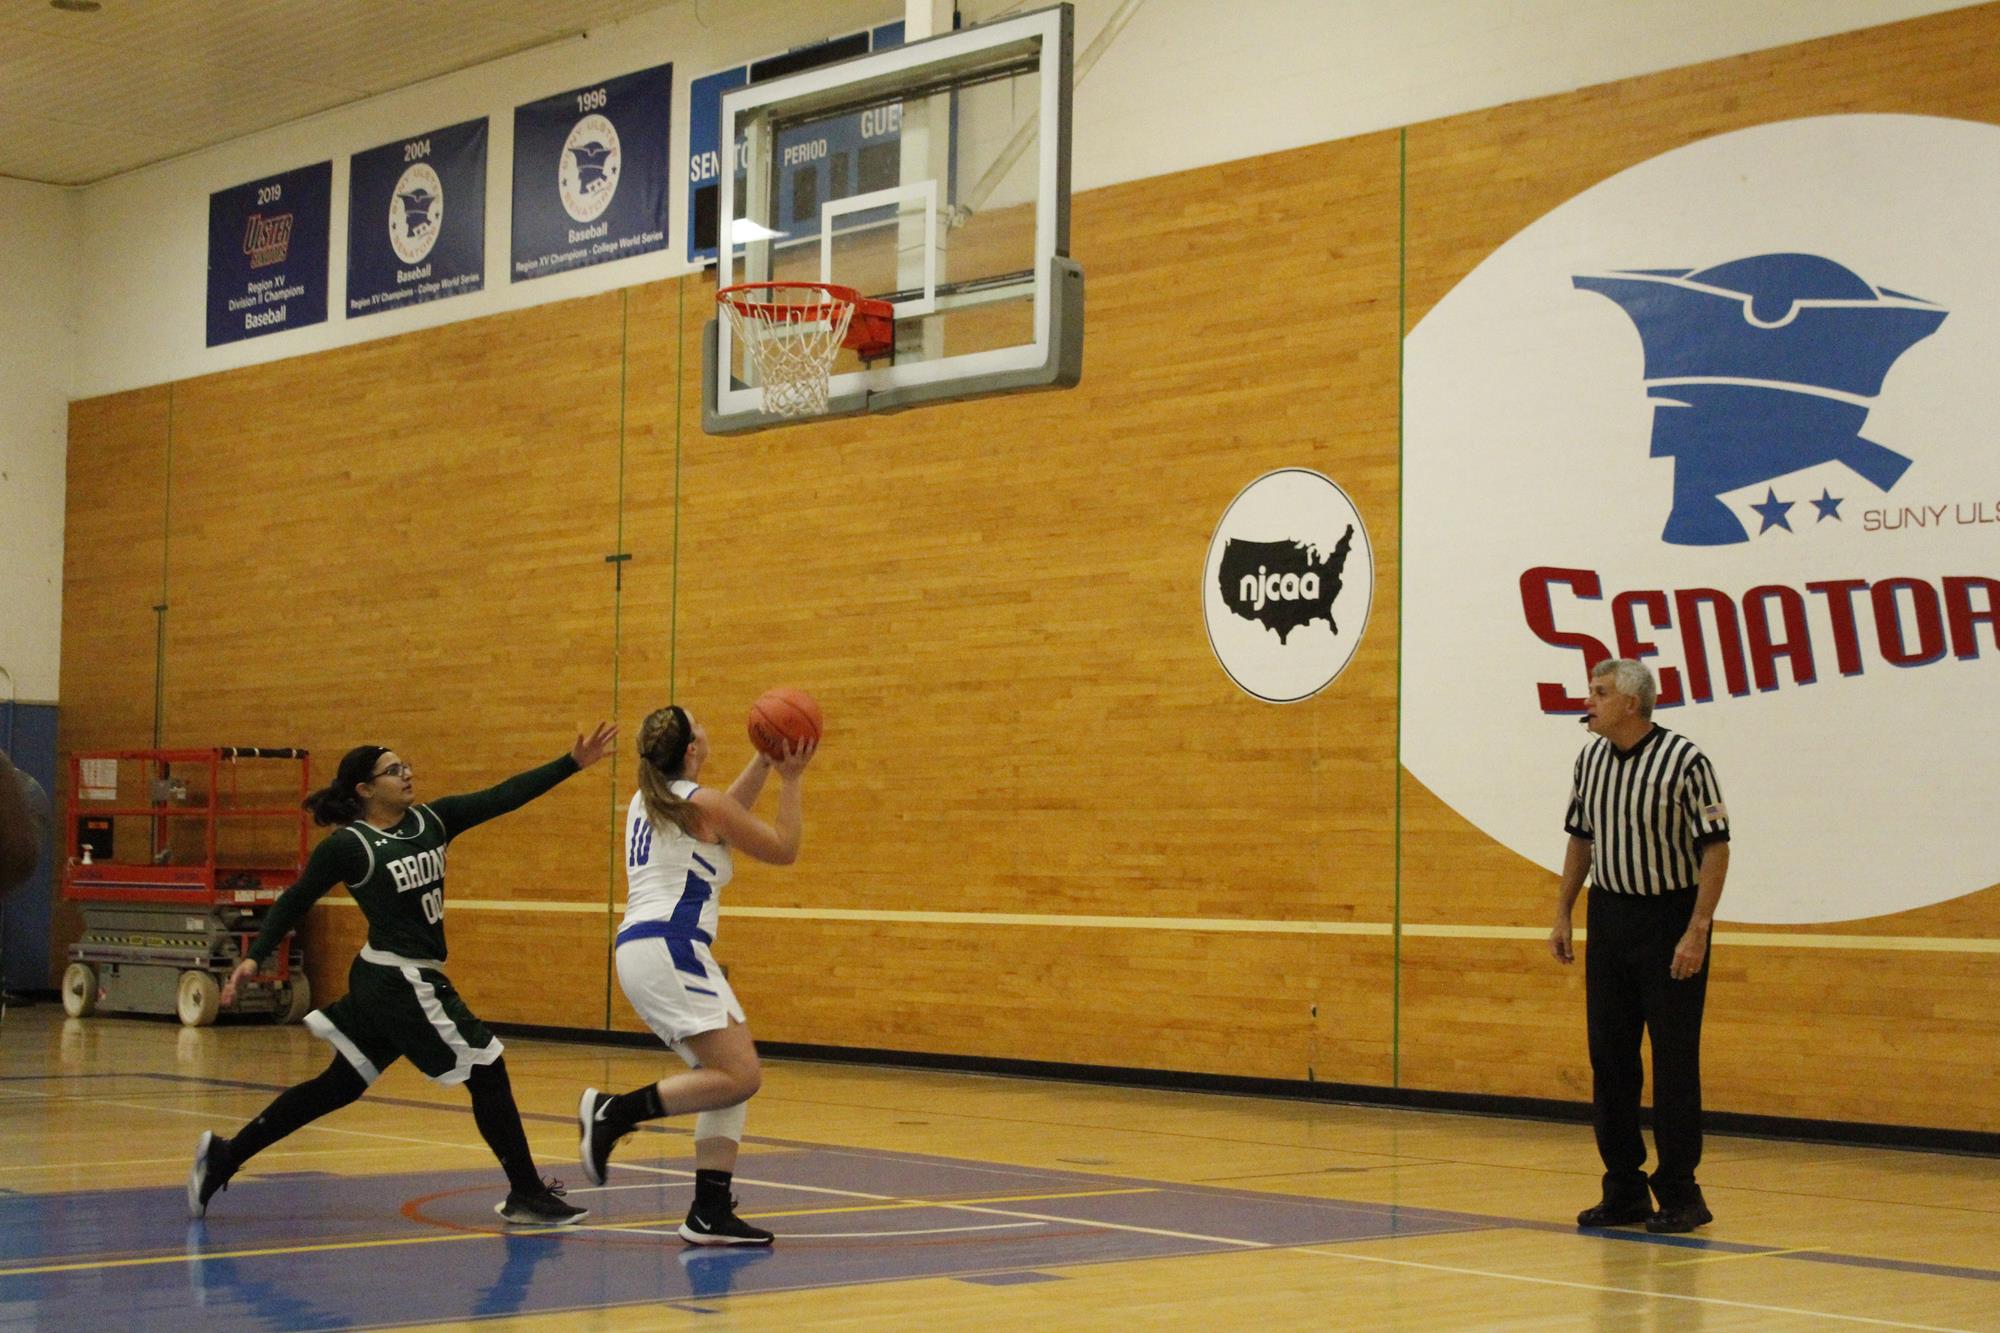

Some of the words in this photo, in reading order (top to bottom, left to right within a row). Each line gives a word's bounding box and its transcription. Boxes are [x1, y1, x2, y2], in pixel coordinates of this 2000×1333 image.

[577, 88, 607, 112] 1996
[861, 103, 903, 139] GUE
[404, 139, 431, 162] 2004
[784, 139, 828, 167] PERIOD
[257, 184, 281, 205] 2019
[568, 221, 608, 244] Baseball
[515, 259, 538, 273] Region
[539, 254, 550, 267] XV
[550, 247, 588, 265] Champions
[592, 240, 619, 256] College
[619, 235, 641, 249] World
[641, 230, 664, 245] Series
[248, 280, 273, 294] Region
[274, 275, 286, 289] XV
[396, 264, 432, 284] Baseball
[229, 296, 257, 311] Division
[264, 285, 305, 303] Champions
[350, 297, 370, 309] Region
[371, 294, 381, 305] XV
[418, 282, 440, 294] College
[441, 276, 460, 289] World
[460, 273, 480, 285] Series
[245, 304, 287, 330] Baseball
[1863, 504, 1948, 532] SUNY
[1956, 501, 2000, 525] UL
[1239, 565, 1320, 611] njcaa
[629, 816, 654, 867] 10
[386, 842, 447, 893] BRON
